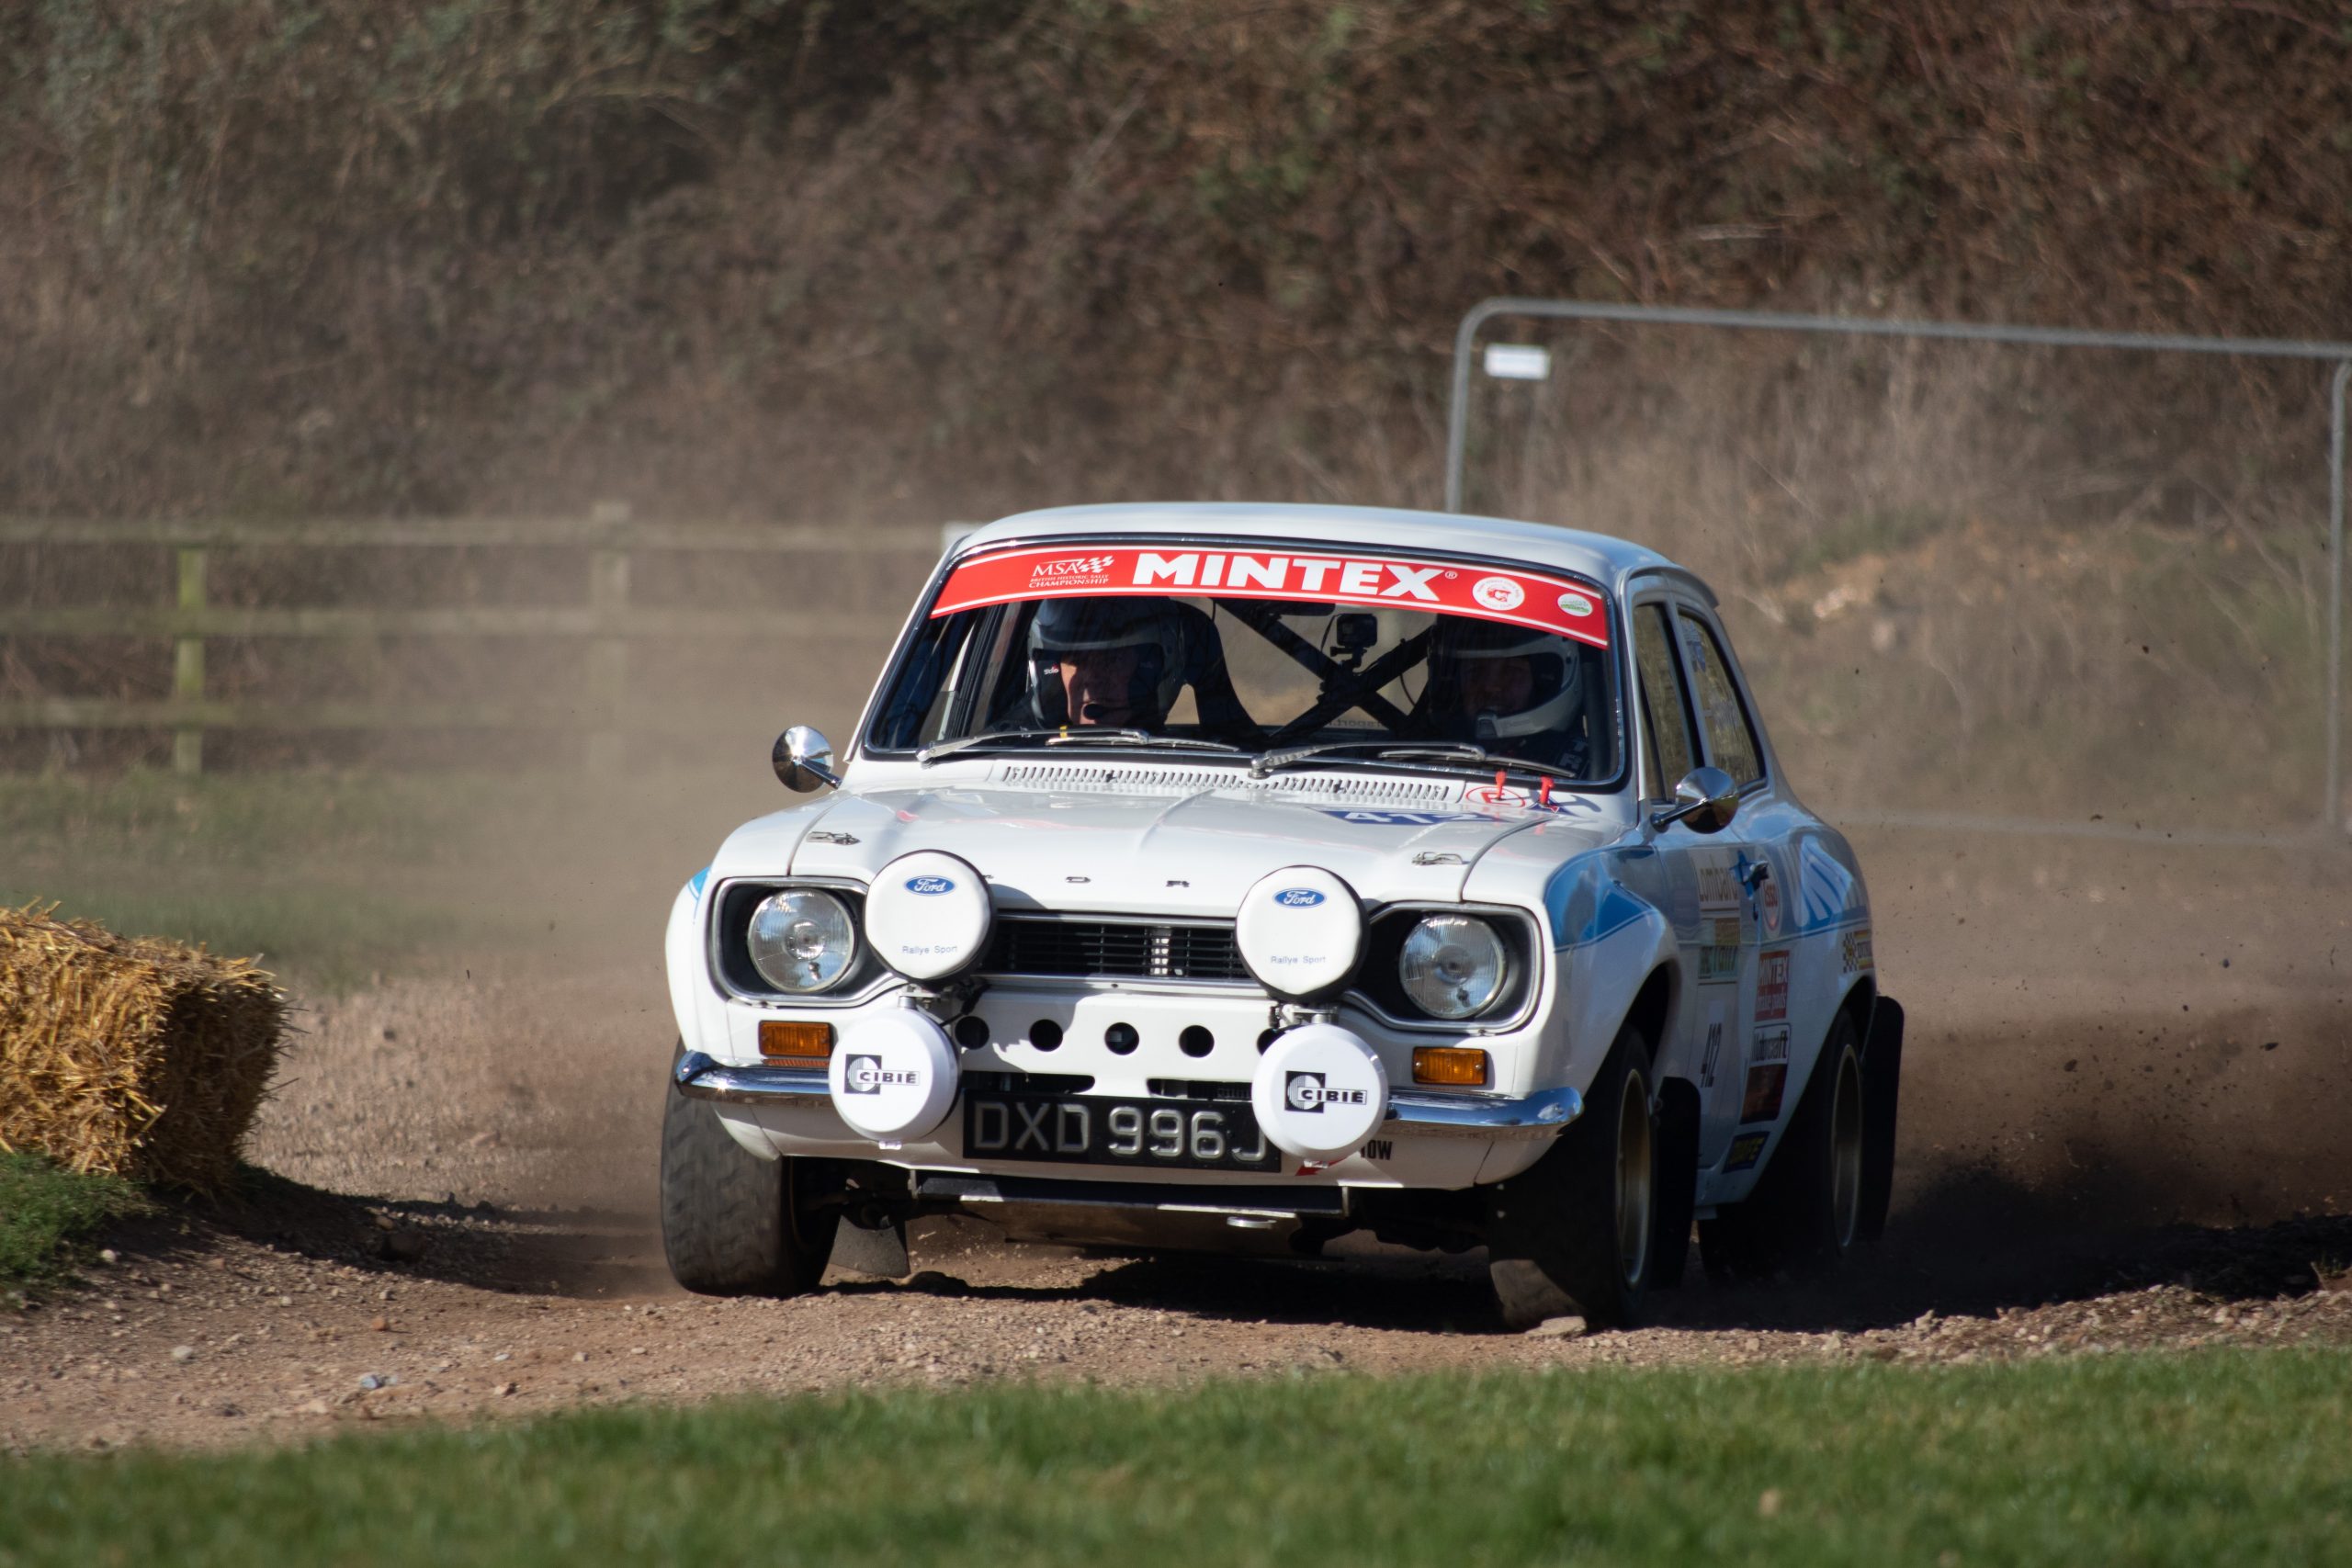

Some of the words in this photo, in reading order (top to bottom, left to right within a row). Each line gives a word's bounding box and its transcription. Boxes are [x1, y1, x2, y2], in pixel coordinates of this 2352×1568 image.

[1033, 562, 1080, 577] MSA
[1028, 578, 1109, 589] CHAMPIONSHIP
[1132, 553, 1445, 602] MINTEX
[913, 878, 946, 892] Ford
[1283, 890, 1317, 905] Ford
[902, 945, 930, 955] Rallye
[934, 945, 957, 954] Sport
[1271, 955, 1298, 965] Rallye
[1303, 955, 1326, 964] Sport
[975, 1101, 1091, 1154] DXD
[1108, 1105, 1267, 1162] 996J
